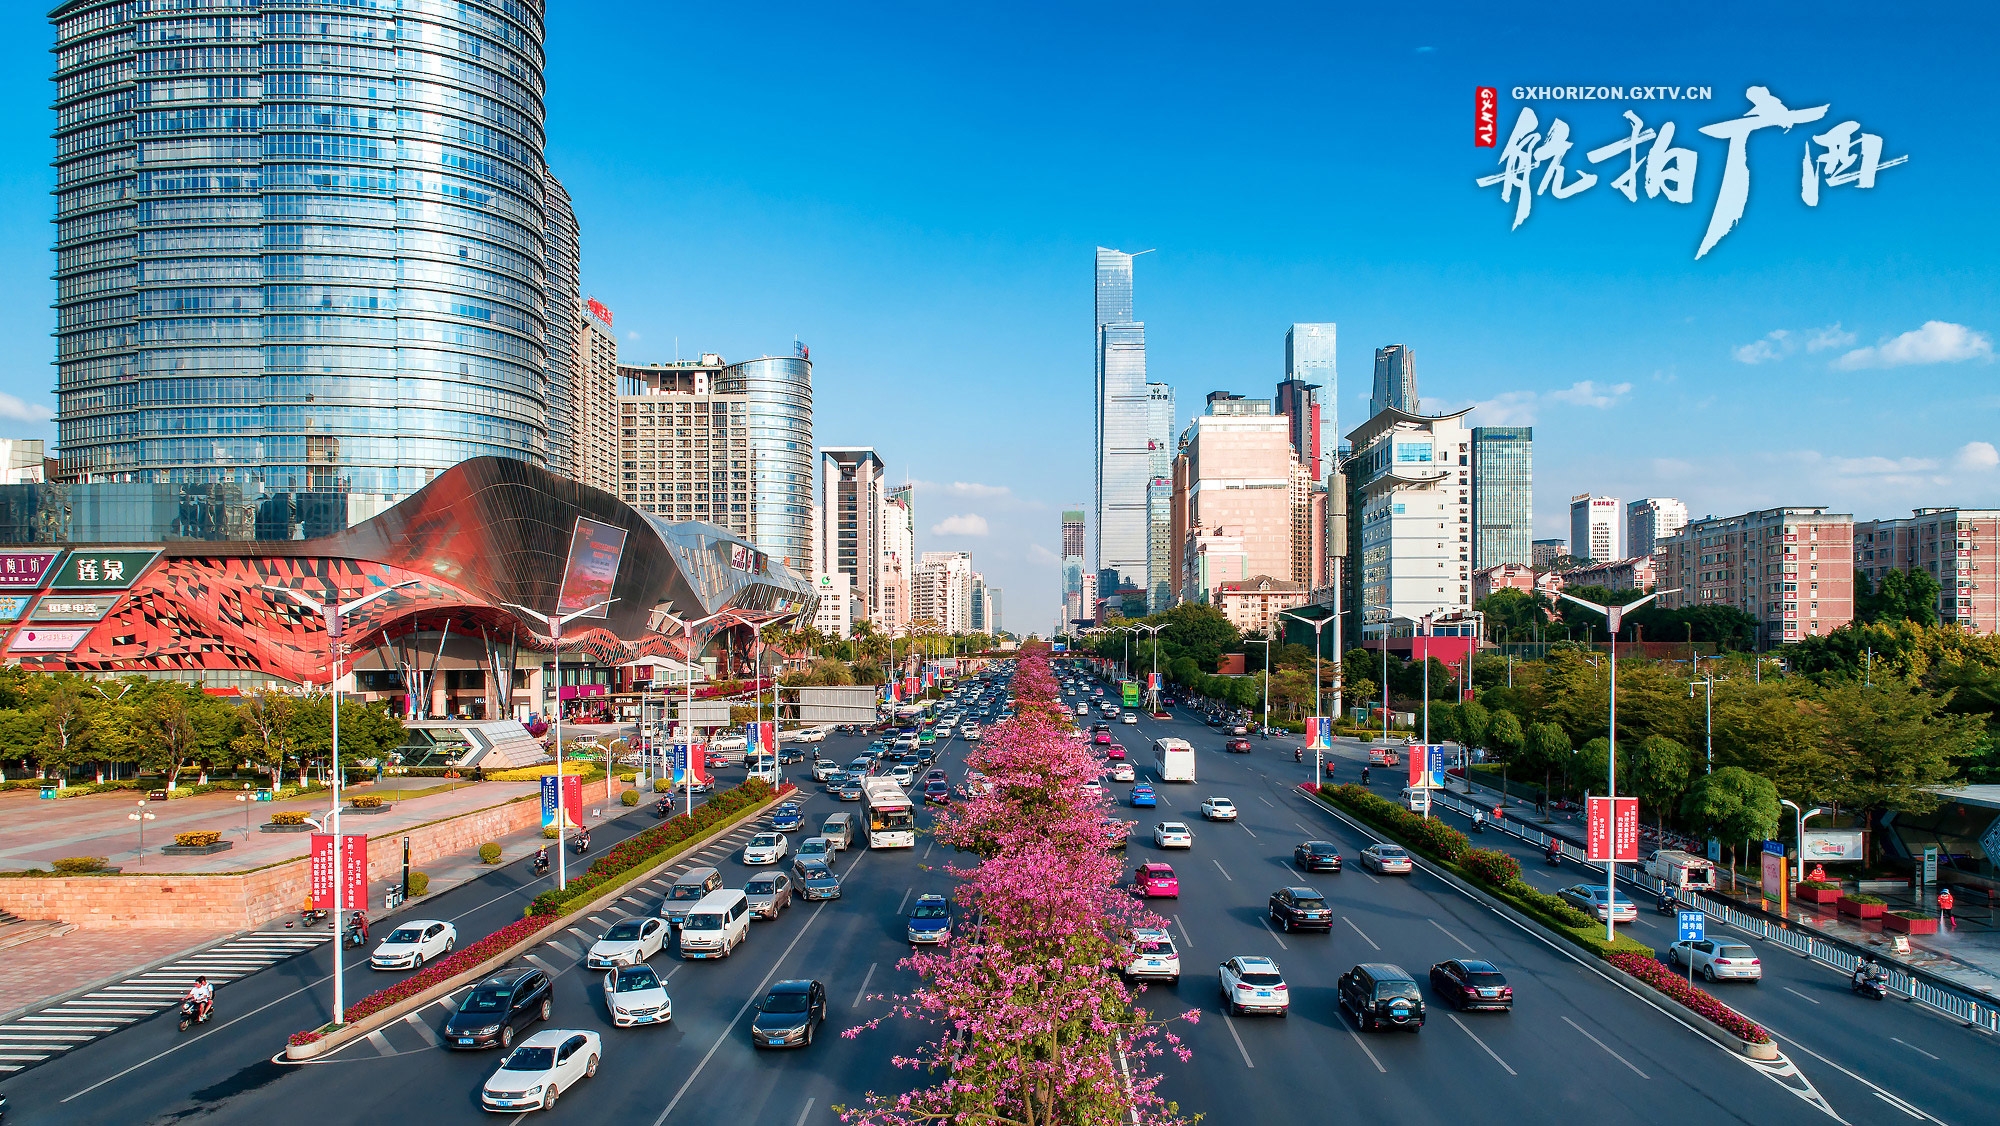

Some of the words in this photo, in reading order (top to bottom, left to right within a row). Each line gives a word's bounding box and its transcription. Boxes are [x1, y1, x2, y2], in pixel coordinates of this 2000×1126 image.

[47, 603, 98, 614] 国美电器
[1681, 913, 1703, 922] 会展路
[1681, 922, 1703, 931] 越秀路
